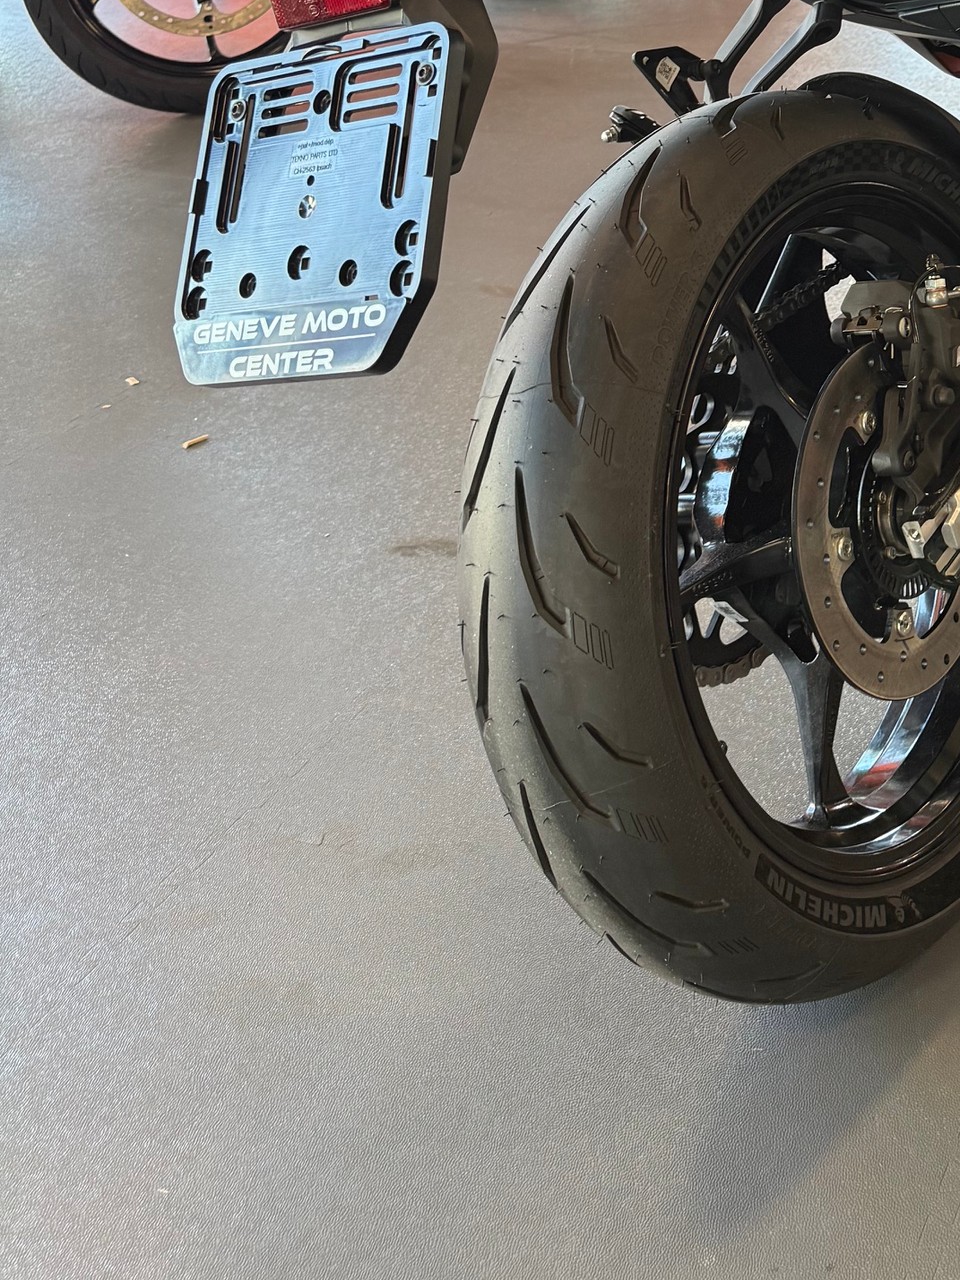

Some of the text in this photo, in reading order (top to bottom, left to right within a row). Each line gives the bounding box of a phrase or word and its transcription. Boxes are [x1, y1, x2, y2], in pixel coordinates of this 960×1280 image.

[193, 303, 387, 345] GENEVE MOTO
[228, 347, 335, 379] CENTER
[767, 867, 888, 929] MICHELIN
